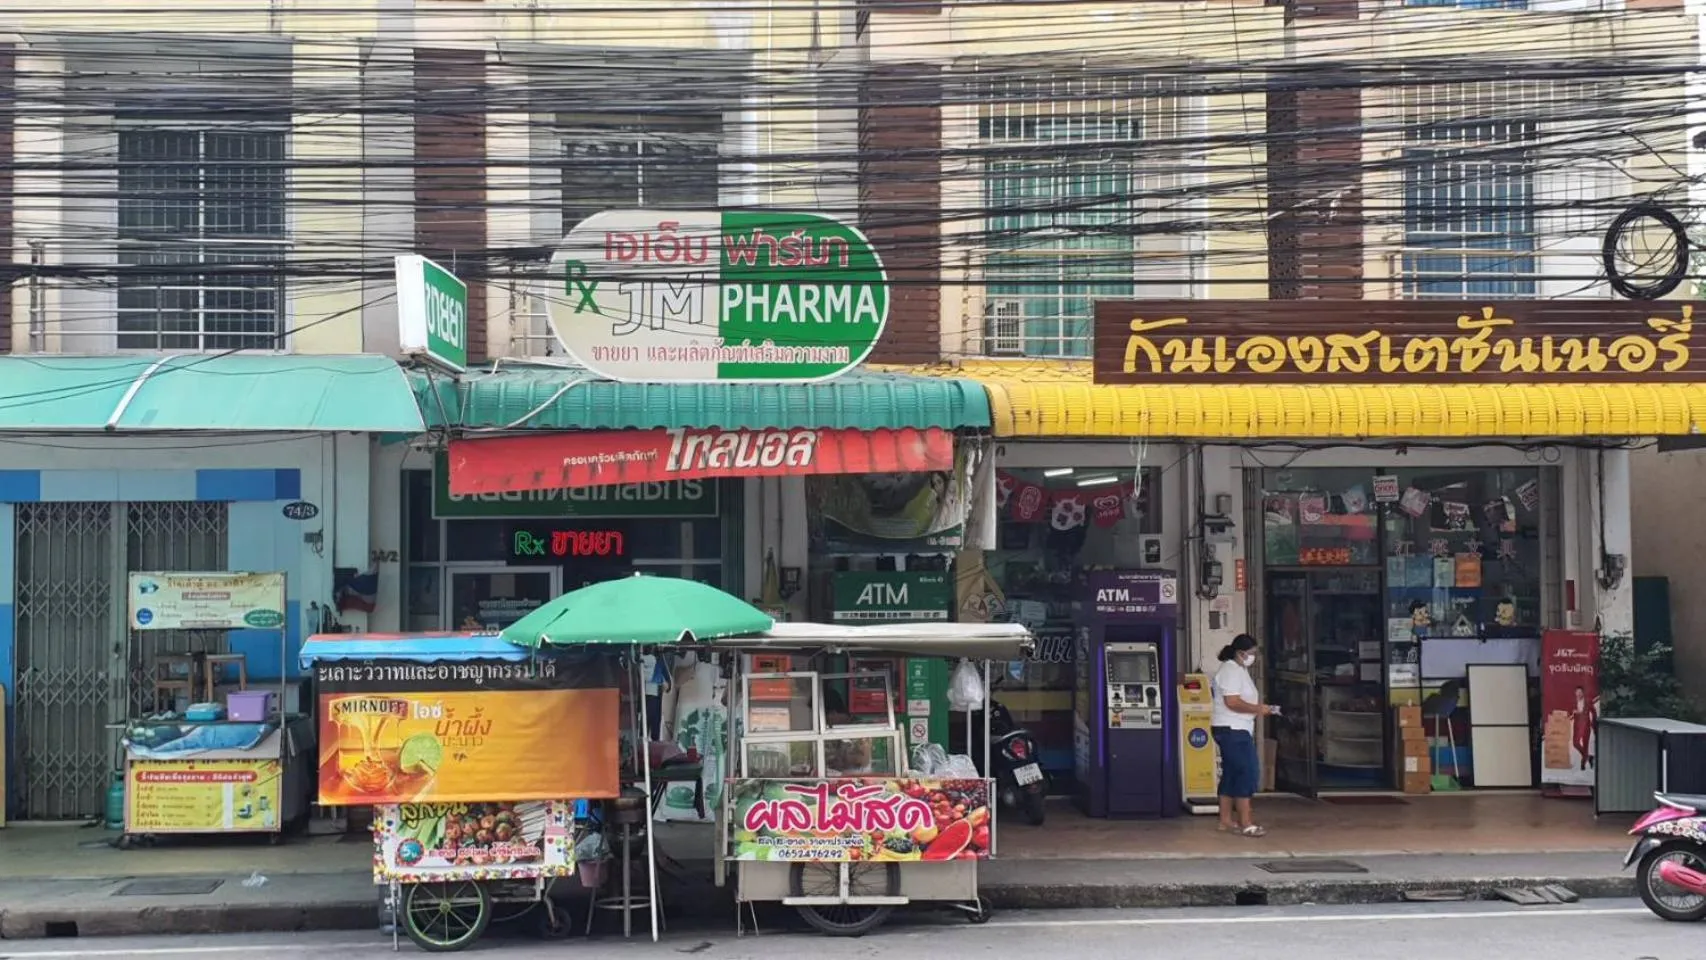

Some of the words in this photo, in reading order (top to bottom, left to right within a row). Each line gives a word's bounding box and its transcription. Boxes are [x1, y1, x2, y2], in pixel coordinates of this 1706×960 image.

[604, 221, 709, 266] เจเอ็ม
[725, 229, 849, 267] ฟาร์มา
[424, 281, 464, 351] ขายยา
[612, 271, 706, 336] JM
[722, 284, 880, 323] PHARMA
[591, 345, 639, 362] ขายยา
[648, 340, 850, 364] และผลิตภัณฑ์เสริมความงาม
[1123, 306, 1693, 374] กันเองสเตชั่นเนอรี่
[286, 505, 316, 518] 74/3
[514, 530, 545, 555] Rx
[551, 530, 624, 556] ขายยา
[855, 582, 909, 606] ATM
[1096, 588, 1130, 602] ATM
[333, 699, 405, 716] SMIRNOFF
[411, 700, 443, 720] ไอซ์
[435, 706, 493, 737] น้ำผึ้ง
[744, 782, 935, 833] ผลไม้สด
[778, 849, 843, 859] 0652476292
